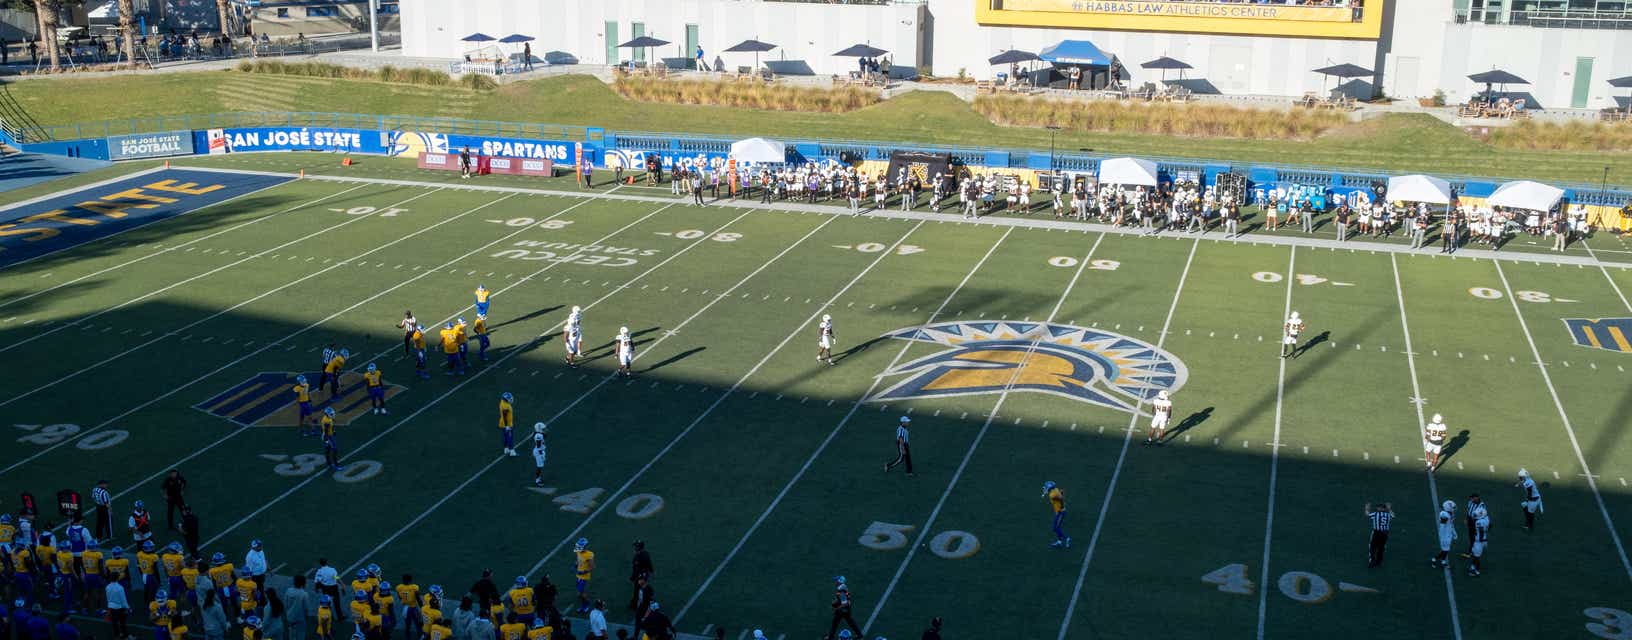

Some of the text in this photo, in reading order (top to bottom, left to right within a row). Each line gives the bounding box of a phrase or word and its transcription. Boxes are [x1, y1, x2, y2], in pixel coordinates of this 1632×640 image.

[1087, 4, 1277, 17] HABBAS LAW ATHLETICS CENTER
[122, 141, 181, 155] FOOTBALL
[224, 132, 259, 146] SAN
[263, 127, 310, 146] JOSÉ
[314, 132, 361, 148] STATE
[482, 140, 567, 160] SPARTANS
[552, 487, 665, 520] 40
[858, 521, 981, 559] 50
[1201, 563, 1333, 604] 40
